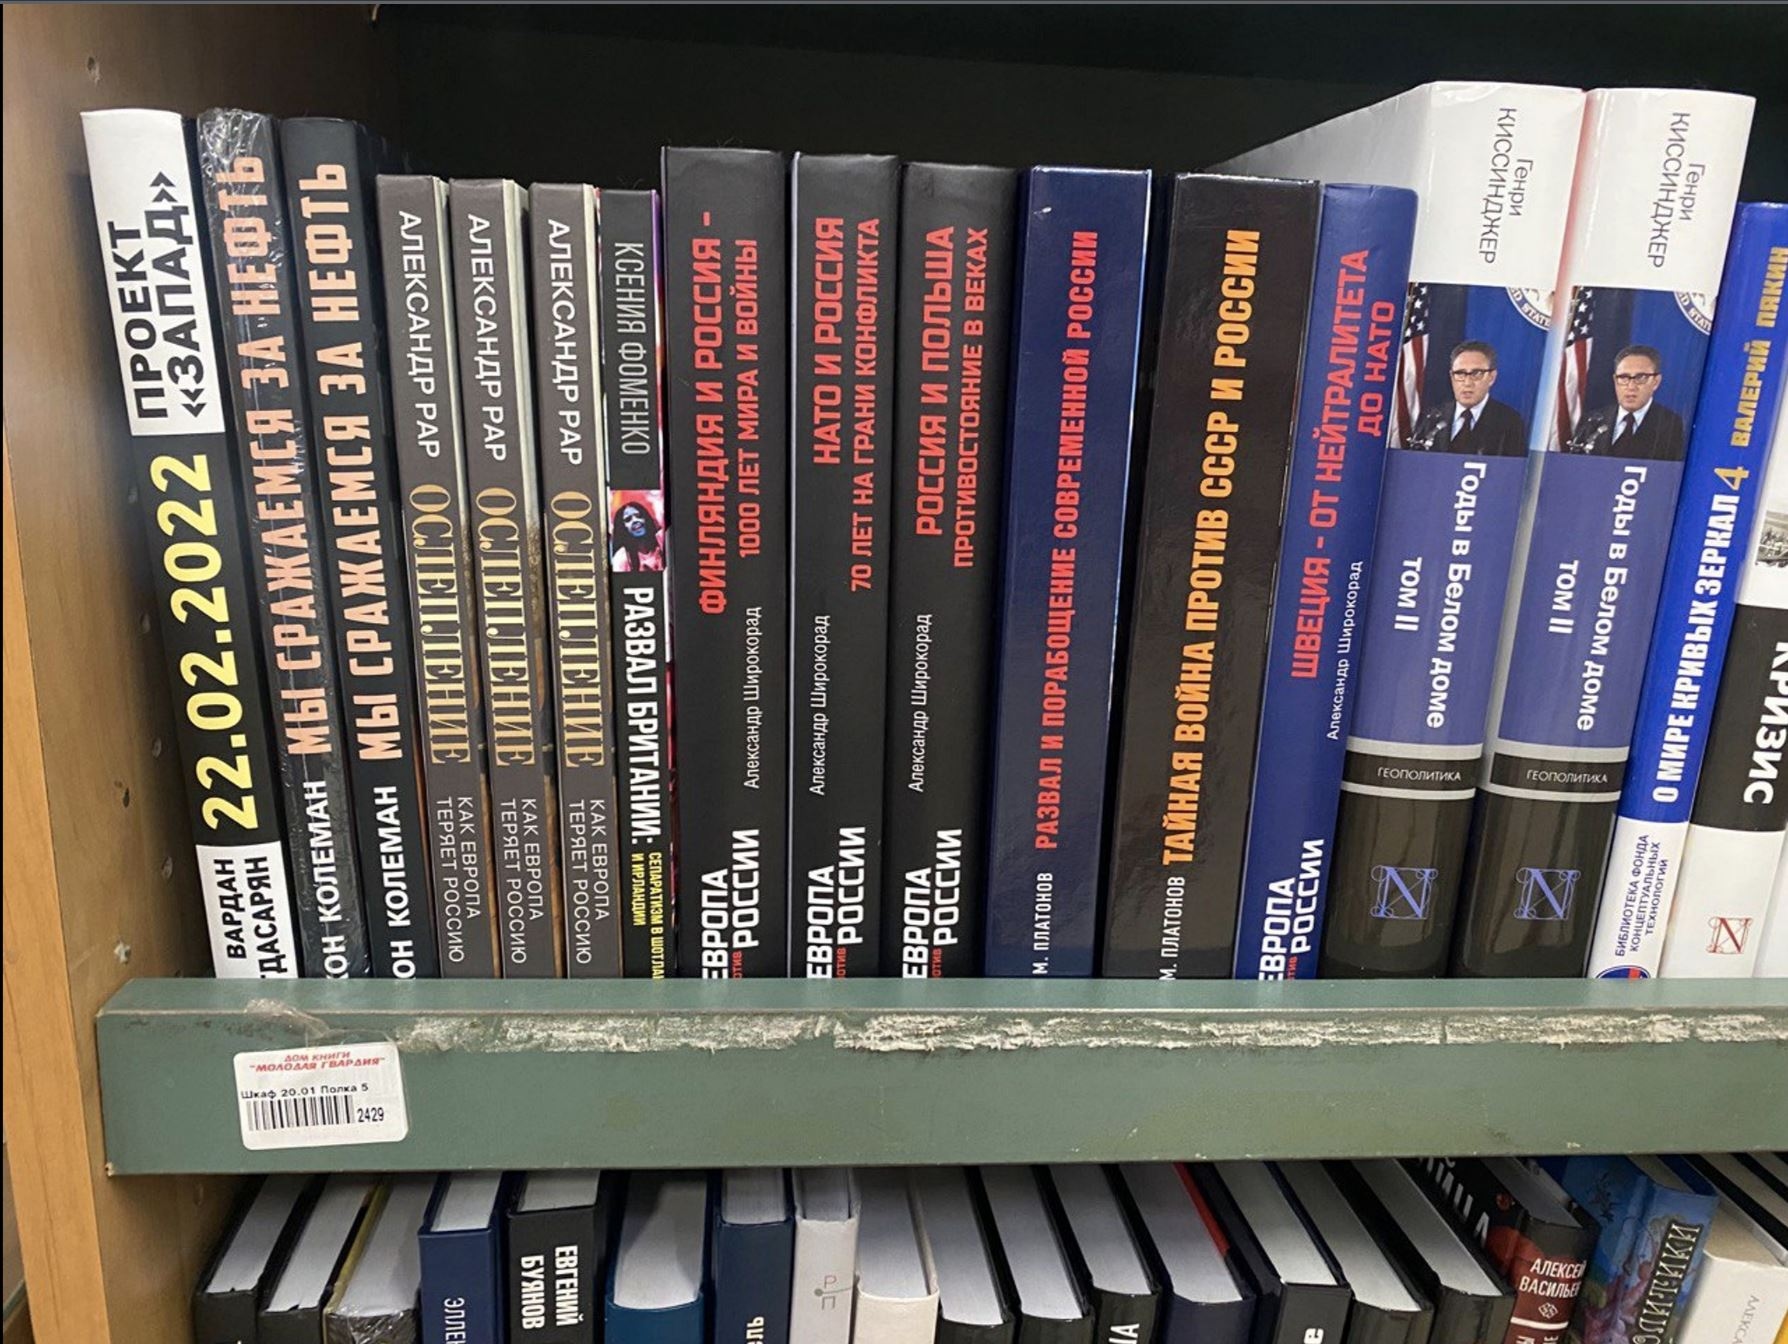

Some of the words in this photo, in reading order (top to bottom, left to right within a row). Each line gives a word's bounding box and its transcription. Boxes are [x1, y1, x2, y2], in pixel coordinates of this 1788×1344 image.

[1479, 107, 1517, 264] КИССИНДЖЕР
[1508, 158, 1534, 216] Генри
[1648, 112, 1690, 268] КИССИНДЖЕР
[1679, 163, 1705, 221] Генри
[217, 157, 281, 316] НЕФТЬ
[299, 163, 360, 321] НЕФТЬ
[964, 227, 988, 311] ВЕКАХ
[107, 221, 168, 418] ПРОЕКТ
[143, 171, 207, 418] «ЗАПАД»
[399, 210, 436, 395] АЛЕКСАНДР
[467, 213, 502, 398] АЛЕКСАНДР
[548, 218, 579, 403] АЛЕКСАНДР
[614, 242, 647, 334] КСЕНИЯ
[693, 238, 722, 371] РОССИЯ
[730, 239, 759, 335] ВОЙНЫ
[814, 217, 844, 344] РОССИЯ
[854, 218, 880, 376] КОНФЛИКТА
[921, 226, 955, 372] ПОЛЬША
[1067, 231, 1099, 338] РОССИИ
[1214, 229, 1260, 368] РОССИИ
[237, 336, 289, 390] ЗА
[316, 341, 367, 396] ЗА
[735, 344, 759, 361] И
[813, 354, 842, 375] И
[962, 319, 984, 336] В
[1313, 249, 1369, 483] НЕЙТРАЛИТЕТА
[1365, 301, 1395, 382] НАТО
[1730, 340, 1771, 447] ВАЛЕРИЙ
[1756, 247, 1788, 328] ПЯКИН
[414, 403, 440, 458] РАР
[618, 342, 651, 456] ФОМЕНКО
[695, 382, 723, 402] И
[736, 369, 760, 440] МИРА
[813, 384, 841, 464] НАТО
[853, 384, 876, 465] ГРАНИ
[921, 383, 948, 403] И
[1211, 379, 1244, 400] И
[1357, 392, 1383, 437] ДО
[482, 405, 507, 461] РАР
[558, 410, 583, 465] РАР
[738, 448, 760, 496] ЛЕТ
[953, 344, 983, 568] ПРОТИВОСТОЯНИЕ
[1054, 349, 1090, 539] СОВРЕМЕННОЙ
[1200, 411, 1240, 498] СССР
[696, 414, 729, 614] ФИНЛЯНДИЯ
[852, 472, 875, 504] НА
[916, 415, 947, 536] РОССИЯ
[1309, 489, 1340, 528] ОТ
[1454, 462, 1487, 532] Годы
[1614, 465, 1647, 536] Годы
[1714, 466, 1749, 491] 4
[246, 409, 322, 671] СРАЖАЕМСЯ
[322, 415, 394, 676] СРАЖАЕМСЯ
[739, 502, 760, 558] 1000
[851, 512, 874, 557] ЛЕТ
[1185, 508, 1229, 631] ПРОТИВ
[1452, 540, 1470, 556] в
[1609, 544, 1627, 560] в
[1694, 494, 1740, 596] ЗЕРКАЛ
[851, 563, 872, 592] 70
[1291, 557, 1331, 679] ШВЕЦИЯ
[1437, 563, 1471, 653] Белом
[1593, 567, 1628, 656] Белом
[150, 454, 258, 830] 22.02.2022
[409, 484, 471, 764] ОСЛЕПЛЕНИЕ
[476, 486, 535, 767] ОСЛЕПЛЕНИЕ
[551, 491, 605, 768] ОСЛЕПЛЕНИЕ
[623, 586, 658, 695] РАЗВАЛ
[743, 607, 763, 701] Широкорад
[810, 615, 831, 707] Широкорад
[910, 614, 932, 705] Широкорад
[1042, 547, 1076, 727] ПОРАБОЩЕНИЕ
[1326, 658, 1348, 741] Александр
[1337, 561, 1363, 653] Широкорад
[1394, 615, 1419, 632] II
[1548, 617, 1574, 634] II
[1671, 600, 1718, 710] КРИВЫХ
[280, 688, 332, 755] МЫ
[354, 694, 403, 760] МЫ
[1175, 641, 1215, 742] ВОЙНА
[1426, 659, 1451, 729] доме
[1577, 662, 1604, 732] доме
[627, 700, 662, 845] БРИТАНИИ:
[743, 706, 763, 789] Александр
[809, 712, 828, 796] Александр
[909, 710, 930, 792] Александр
[1040, 735, 1064, 750] И
[1377, 766, 1462, 783] ГЕОПОЛИТИКА
[1526, 769, 1608, 784] ГЕОПОЛИТИКА
[1656, 714, 1694, 782] МИРЕ
[436, 796, 457, 870] ТЕРЯЕТ
[457, 797, 475, 834] КАК
[500, 798, 520, 872] ТЕРЯЕТ
[521, 798, 539, 836] КАК
[569, 799, 587, 872] ТЕРЯЕТ
[590, 799, 606, 837] КАК
[1035, 757, 1063, 850] РАЗВАЛ
[1162, 752, 1204, 865] ТАЙНАЯ
[1652, 787, 1679, 803] О
[303, 781, 342, 924] КОЛЕМАН
[373, 785, 412, 927] КОЛЕМАН
[461, 841, 481, 919] ЕВРОПА
[524, 843, 544, 921] ЕВРОПА
[592, 843, 610, 921] ЕВРОПА
[632, 853, 644, 862] И
[648, 851, 663, 925] СЕПАРАТИЗМ
[732, 829, 760, 949] РОССИИ
[837, 826, 866, 945] РОССИИ
[933, 829, 963, 946] РОССИИ
[213, 859, 247, 959] ВАРДАН
[244, 856, 288, 978] ДАСАРЯН
[443, 877, 465, 962] РОССИЮ
[506, 878, 526, 964] РОССИЮ
[573, 879, 592, 964] РОССИЮ
[631, 864, 646, 926] ИРЛАНДИИ
[651, 926, 664, 935] В
[702, 868, 729, 979] ЕВРОПА
[807, 865, 834, 979] ЕВРОПА
[902, 867, 932, 979] ЕВРОПА
[1034, 872, 1053, 951] ПЛАТОНОВ
[1162, 876, 1186, 958] ПЛАТОНОВ
[1290, 839, 1324, 954] РОССИИ
[1615, 880, 1640, 957] БИБЛИОТЕКА
[1632, 835, 1649, 878] ФОНДА
[1630, 841, 1661, 952] КОНЦЕПТУАЛЬНЫХ
[1645, 859, 1668, 935] ТЕХНОЛОГИЙ
[1032, 957, 1050, 975] М.
[1159, 963, 1178, 980] М.
[241, 1090, 276, 1099] Шкаф
[281, 1087, 316, 1096] 20.01
[320, 1085, 357, 1094] Полка
[361, 1083, 369, 1091] 5
[284, 1054, 309, 1062] ДОМ
[312, 1052, 351, 1061] КНИГИ
[357, 1107, 384, 1123] 2429
[521, 1255, 545, 1330] БУЯНОВ
[555, 1245, 585, 1328] ЕВГЕНИЙ
